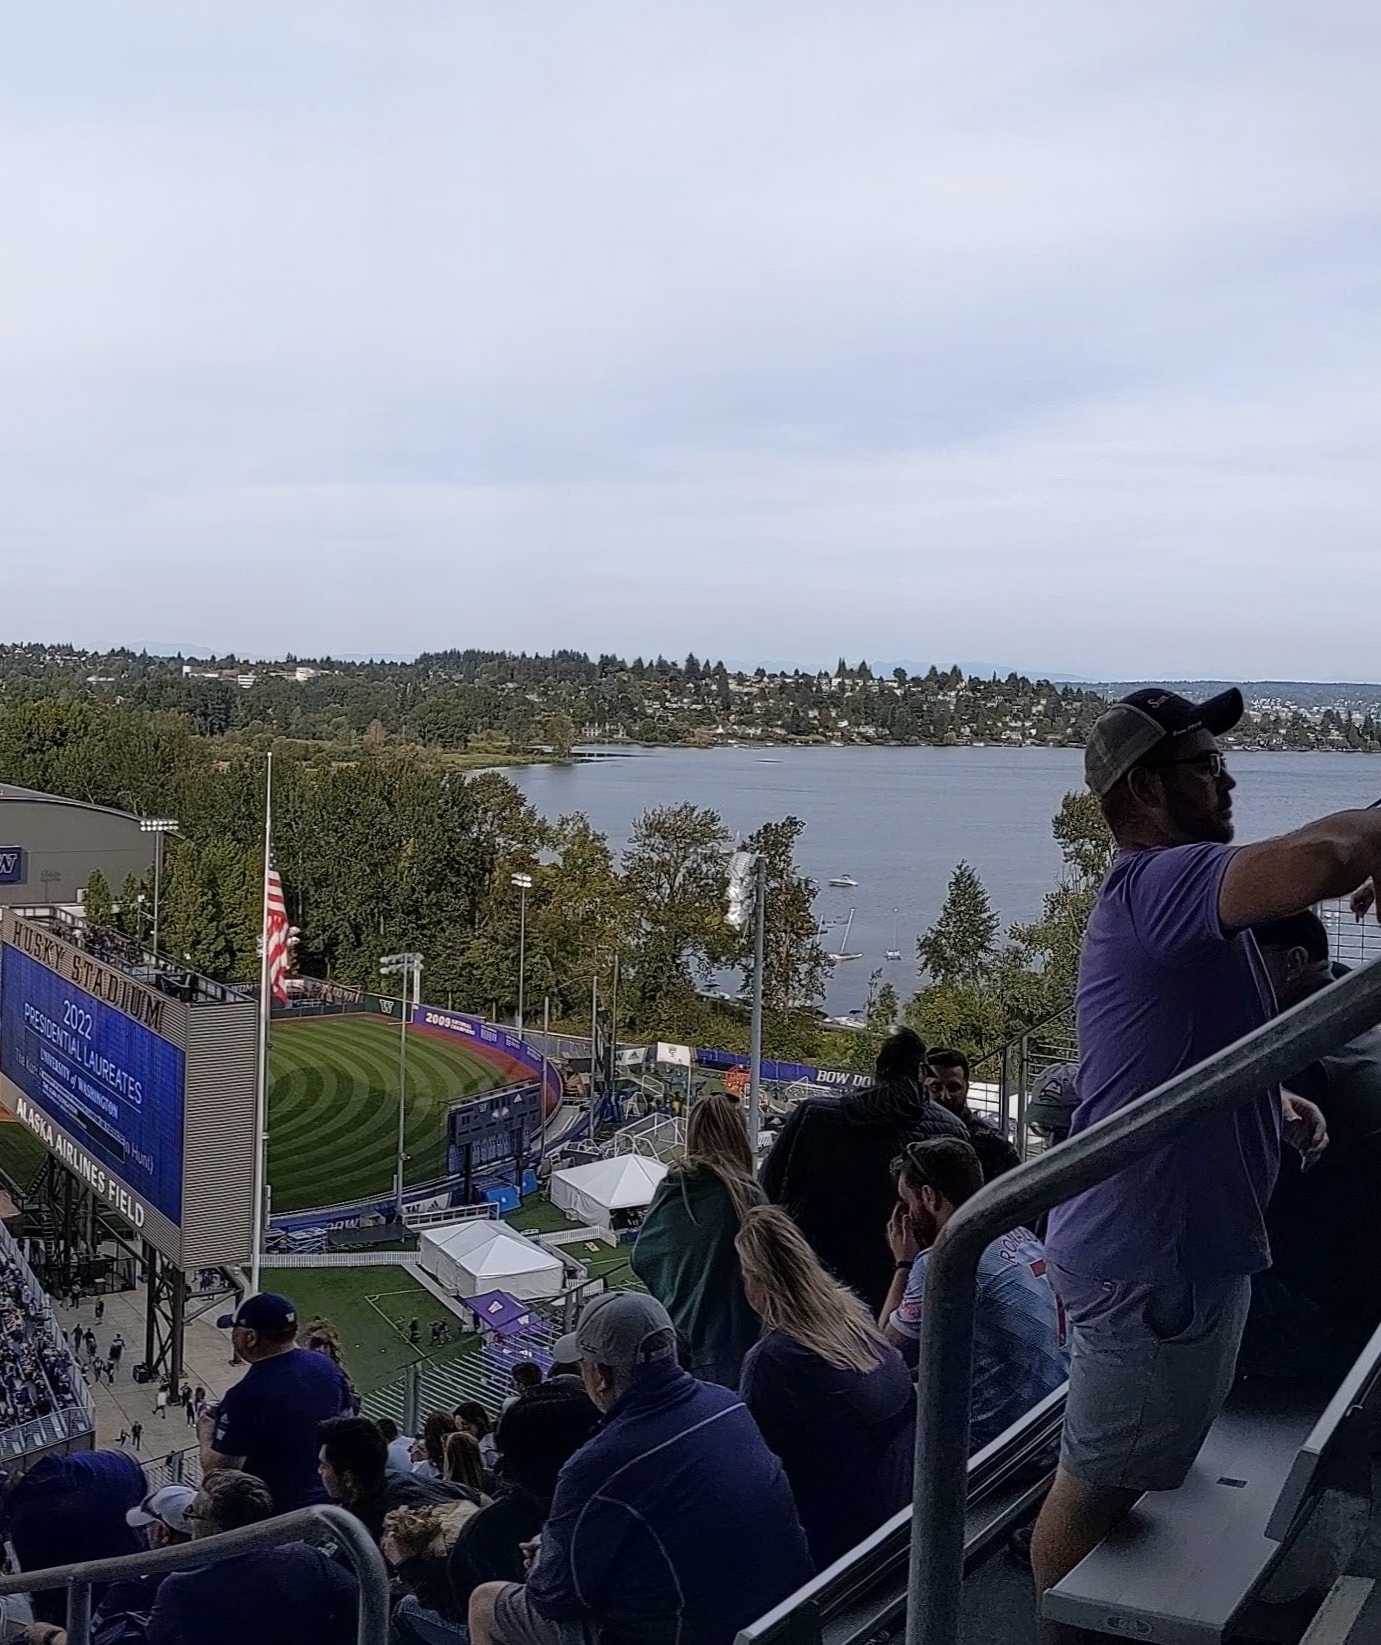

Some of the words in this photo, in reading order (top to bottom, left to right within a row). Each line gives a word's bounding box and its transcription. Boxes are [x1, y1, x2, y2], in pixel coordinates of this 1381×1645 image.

[13, 921, 64, 970] HUSKY
[71, 956, 165, 1033] STADIUM
[25, 1003, 81, 1061] PRESIDENTIAL
[84, 1045, 142, 1105] LAUREATES
[64, 1000, 92, 1040] 2022
[426, 1012, 451, 1028] 2009
[41, 1047, 70, 1080] UNIVERSITY
[78, 1077, 118, 1120] WASHINGTON
[816, 1070, 849, 1085] BOW
[16, 1098, 54, 1147] ALASKA
[55, 1134, 105, 1194] AIRLINES
[108, 1179, 145, 1228] FIELD
